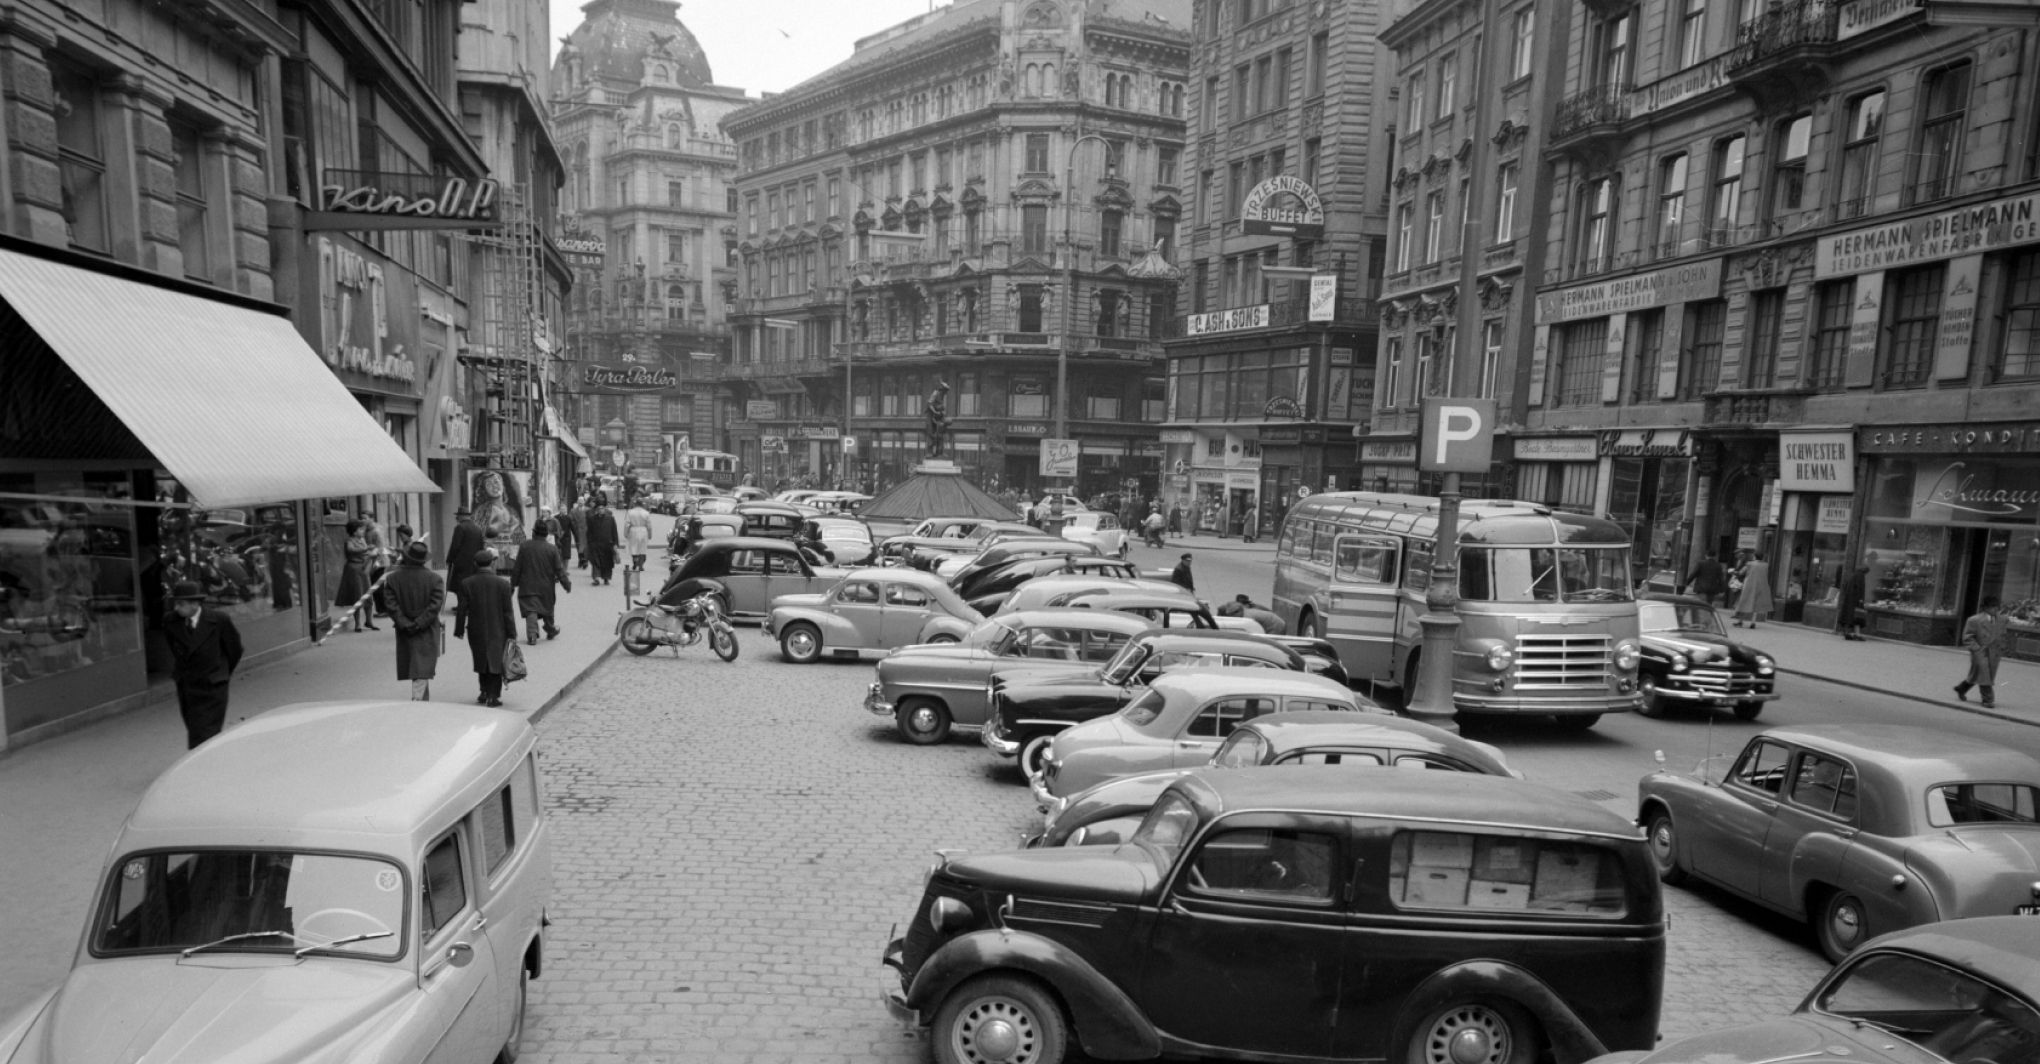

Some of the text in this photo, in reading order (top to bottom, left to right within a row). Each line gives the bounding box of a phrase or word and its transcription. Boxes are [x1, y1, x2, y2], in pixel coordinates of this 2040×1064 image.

[1686, 68, 1706, 93] und
[323, 184, 436, 216] Kino
[1261, 208, 1307, 224] BUFFET
[1833, 199, 2033, 257] HERMANN SPIELMANN
[582, 255, 601, 265] BAR
[1610, 272, 1666, 298] SPIELMANN
[1205, 311, 1225, 332] ASH
[1231, 308, 1261, 328] SONS
[584, 364, 625, 388] Tyra
[626, 365, 679, 387] Perlen
[844, 437, 856, 453] P
[1436, 406, 1482, 464] P
[1785, 443, 1846, 460] SCHWESTER
[1796, 463, 1836, 481] HEMMA
